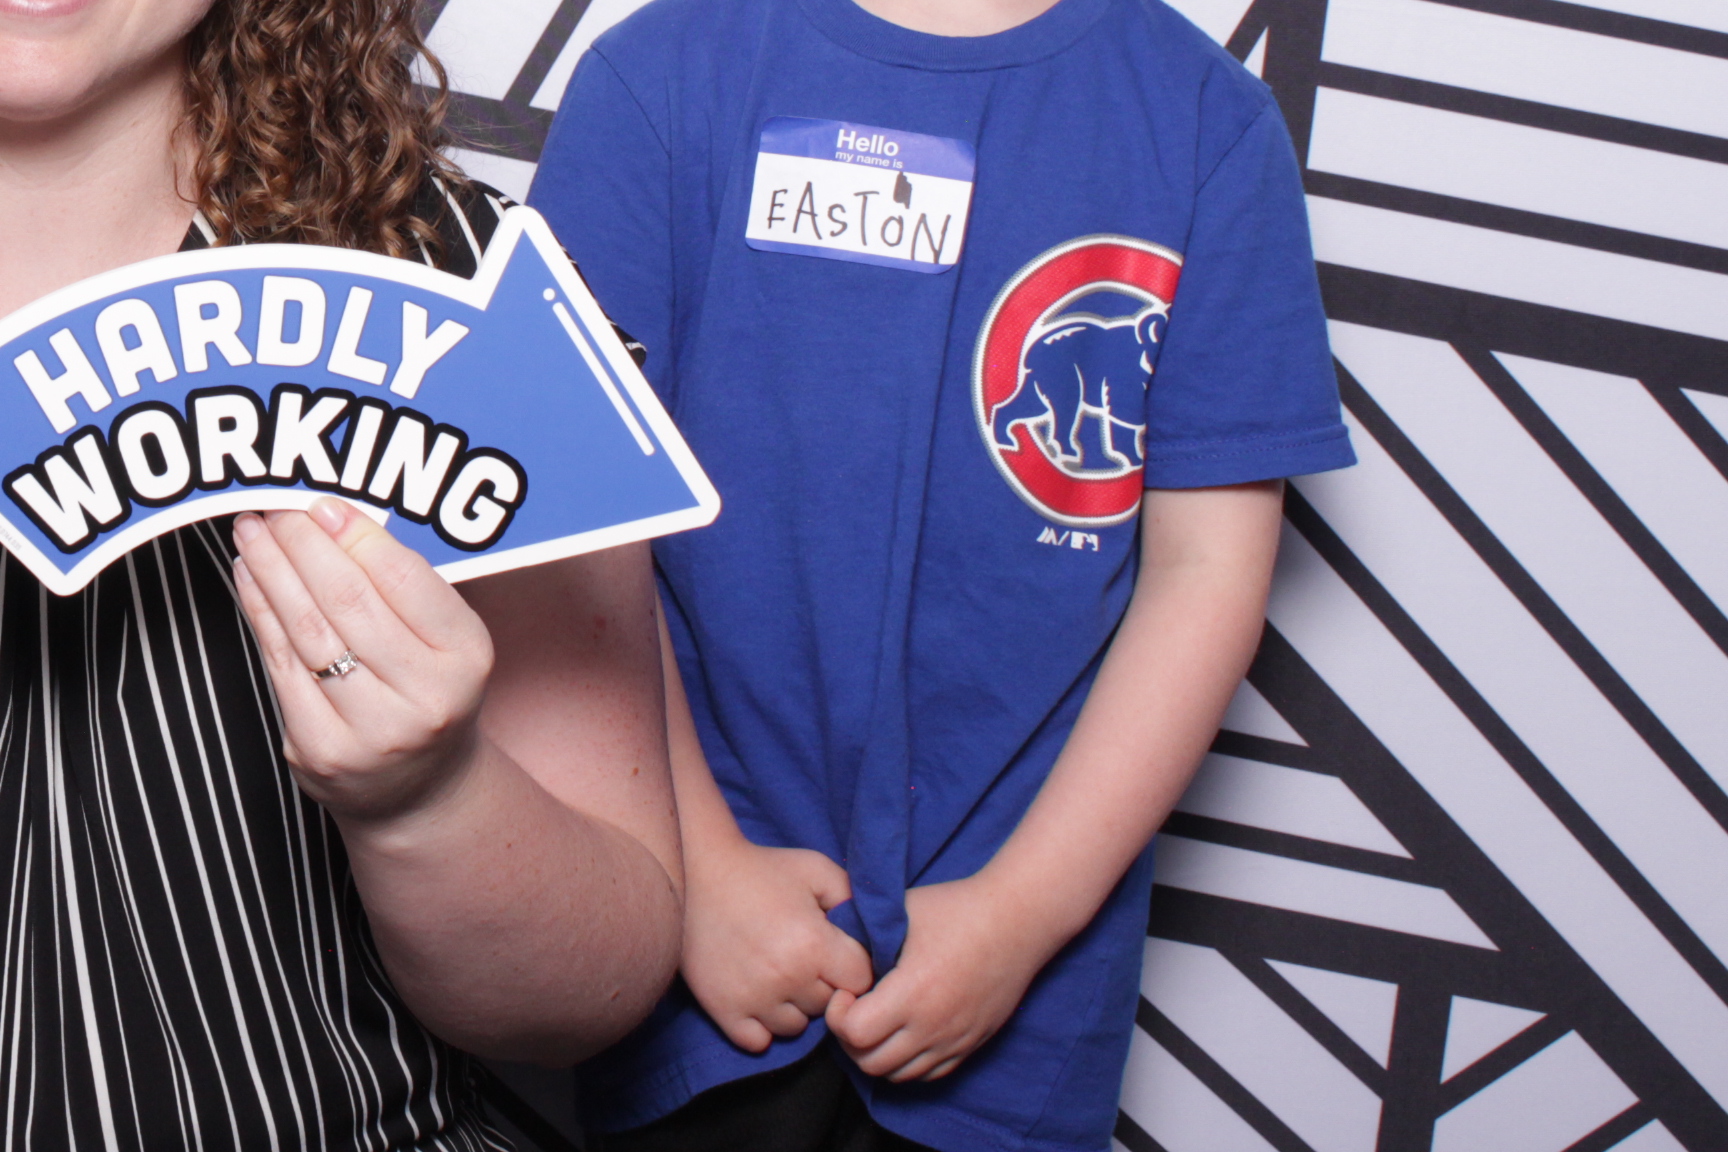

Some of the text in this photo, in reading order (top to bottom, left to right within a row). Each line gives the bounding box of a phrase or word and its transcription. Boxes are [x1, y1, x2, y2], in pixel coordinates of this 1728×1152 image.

[835, 151, 904, 169] my name is
[836, 129, 899, 157] Hello
[767, 181, 952, 264] EASTON
[13, 275, 470, 435] HARDLY
[5, 386, 526, 550] WORKING
